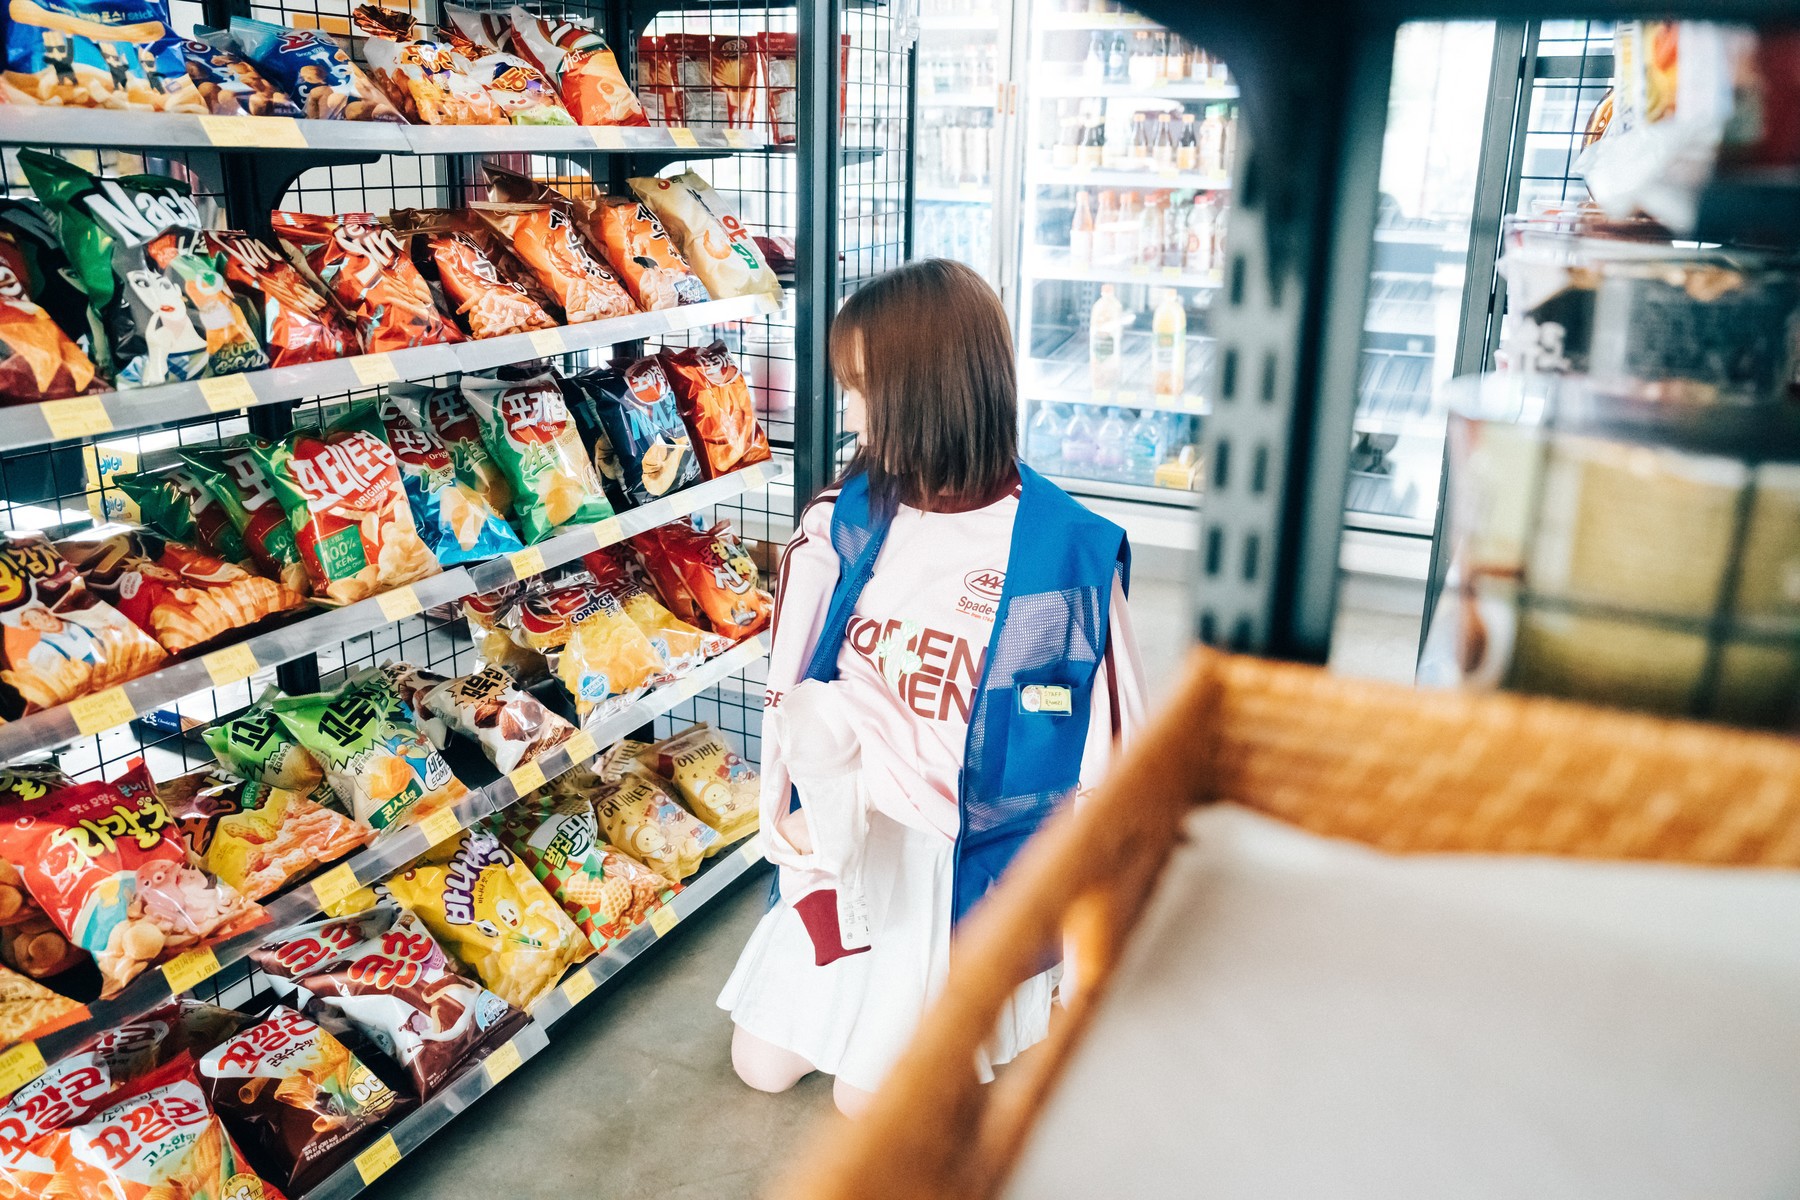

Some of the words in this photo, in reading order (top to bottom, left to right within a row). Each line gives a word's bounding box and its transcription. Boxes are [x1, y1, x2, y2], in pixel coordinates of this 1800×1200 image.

[562, 49, 584, 72] Hot
[353, 476, 392, 509] ORIGINAL
[51, 796, 173, 874] 자갈치
[89, 1096, 208, 1171] 꼬깔콘
